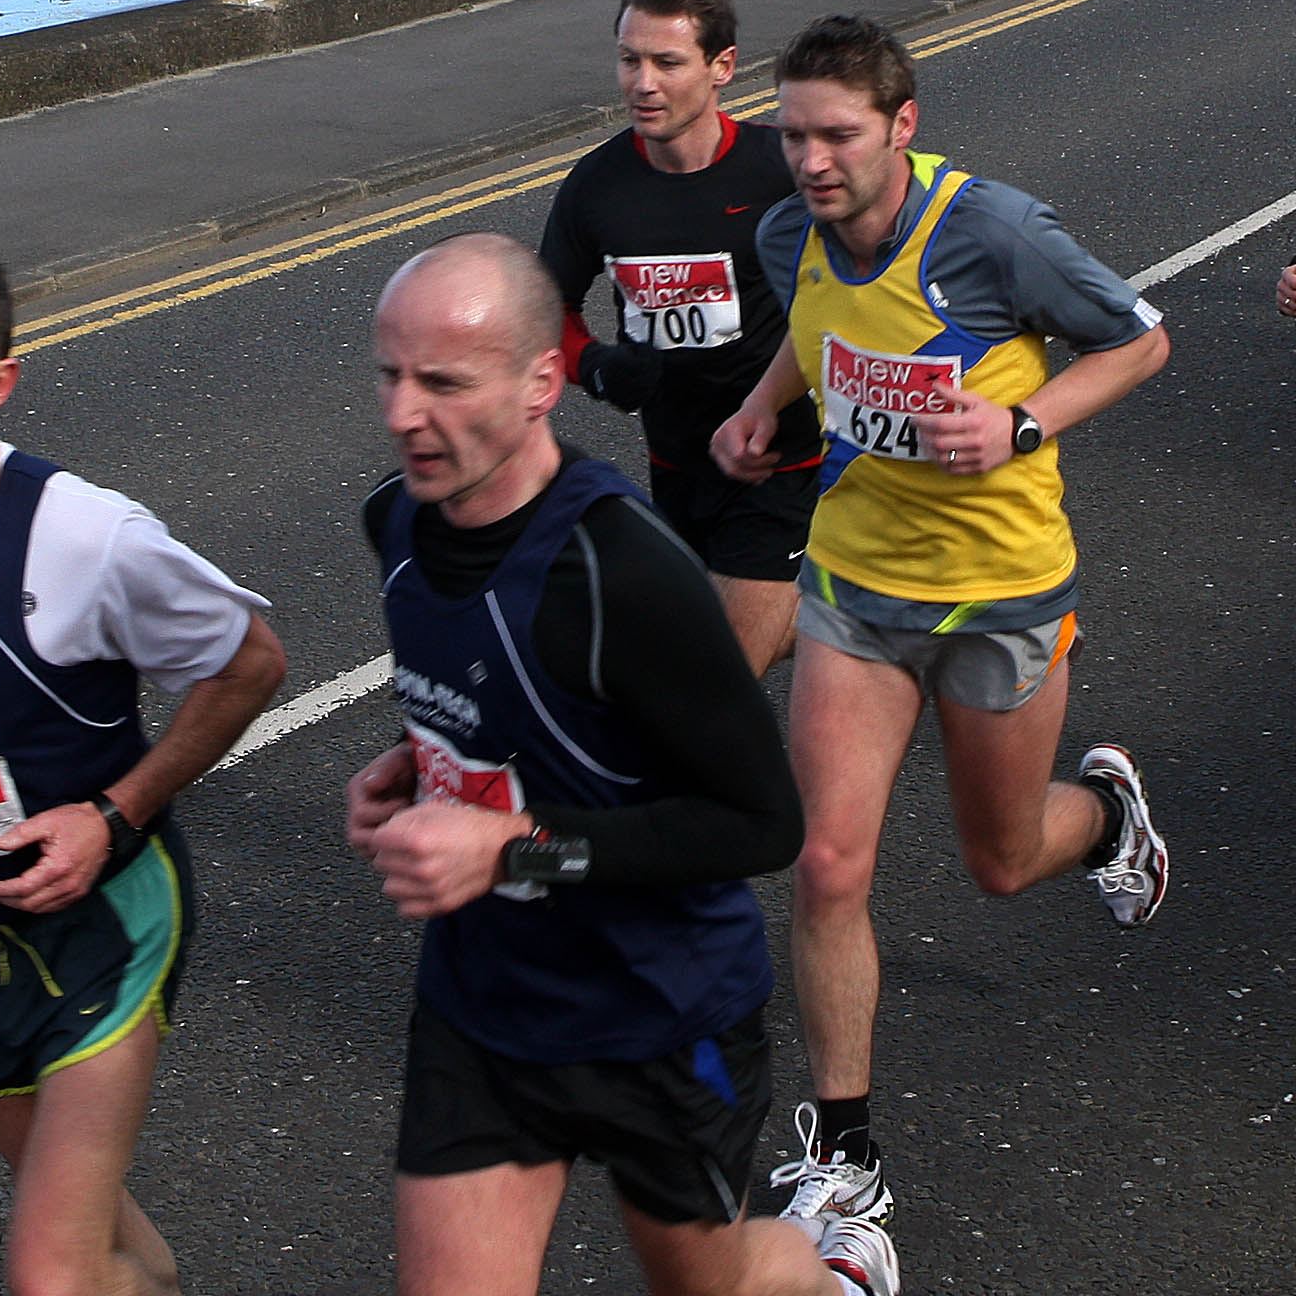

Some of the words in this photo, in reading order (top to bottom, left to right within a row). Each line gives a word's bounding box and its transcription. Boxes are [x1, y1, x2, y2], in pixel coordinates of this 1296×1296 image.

[638, 263, 692, 285] new
[642, 305, 705, 345] 700
[831, 361, 946, 412] balance
[854, 354, 912, 385] new
[849, 405, 919, 458] 624
